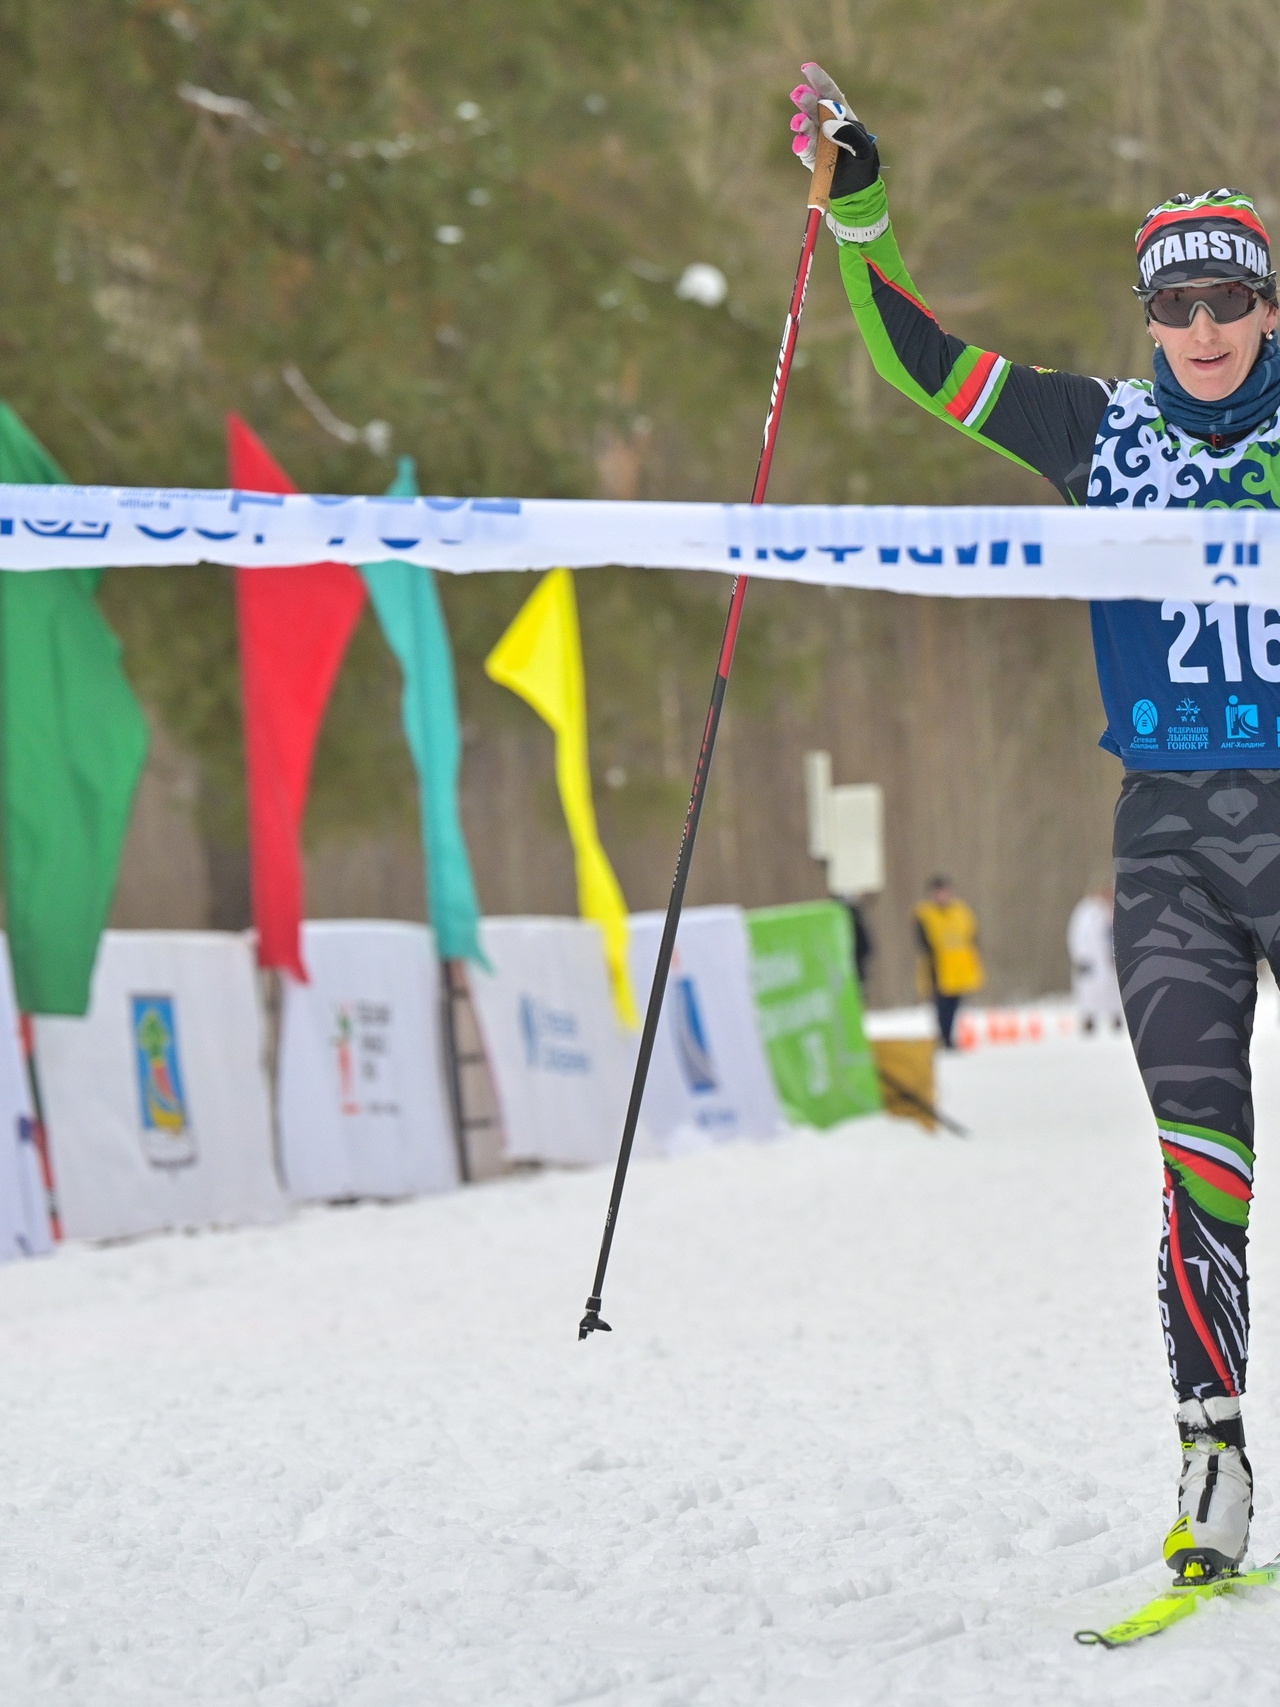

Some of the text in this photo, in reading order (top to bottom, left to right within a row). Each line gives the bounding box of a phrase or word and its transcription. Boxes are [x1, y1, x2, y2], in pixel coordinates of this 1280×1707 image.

[1167, 726, 1209, 734] ФЕДЕРАЦИЯ
[1133, 735, 1157, 744] Сетевая
[1167, 733, 1209, 742] ЛЫЖНЫХ
[1167, 741, 1209, 750] ГОНОК РТ
